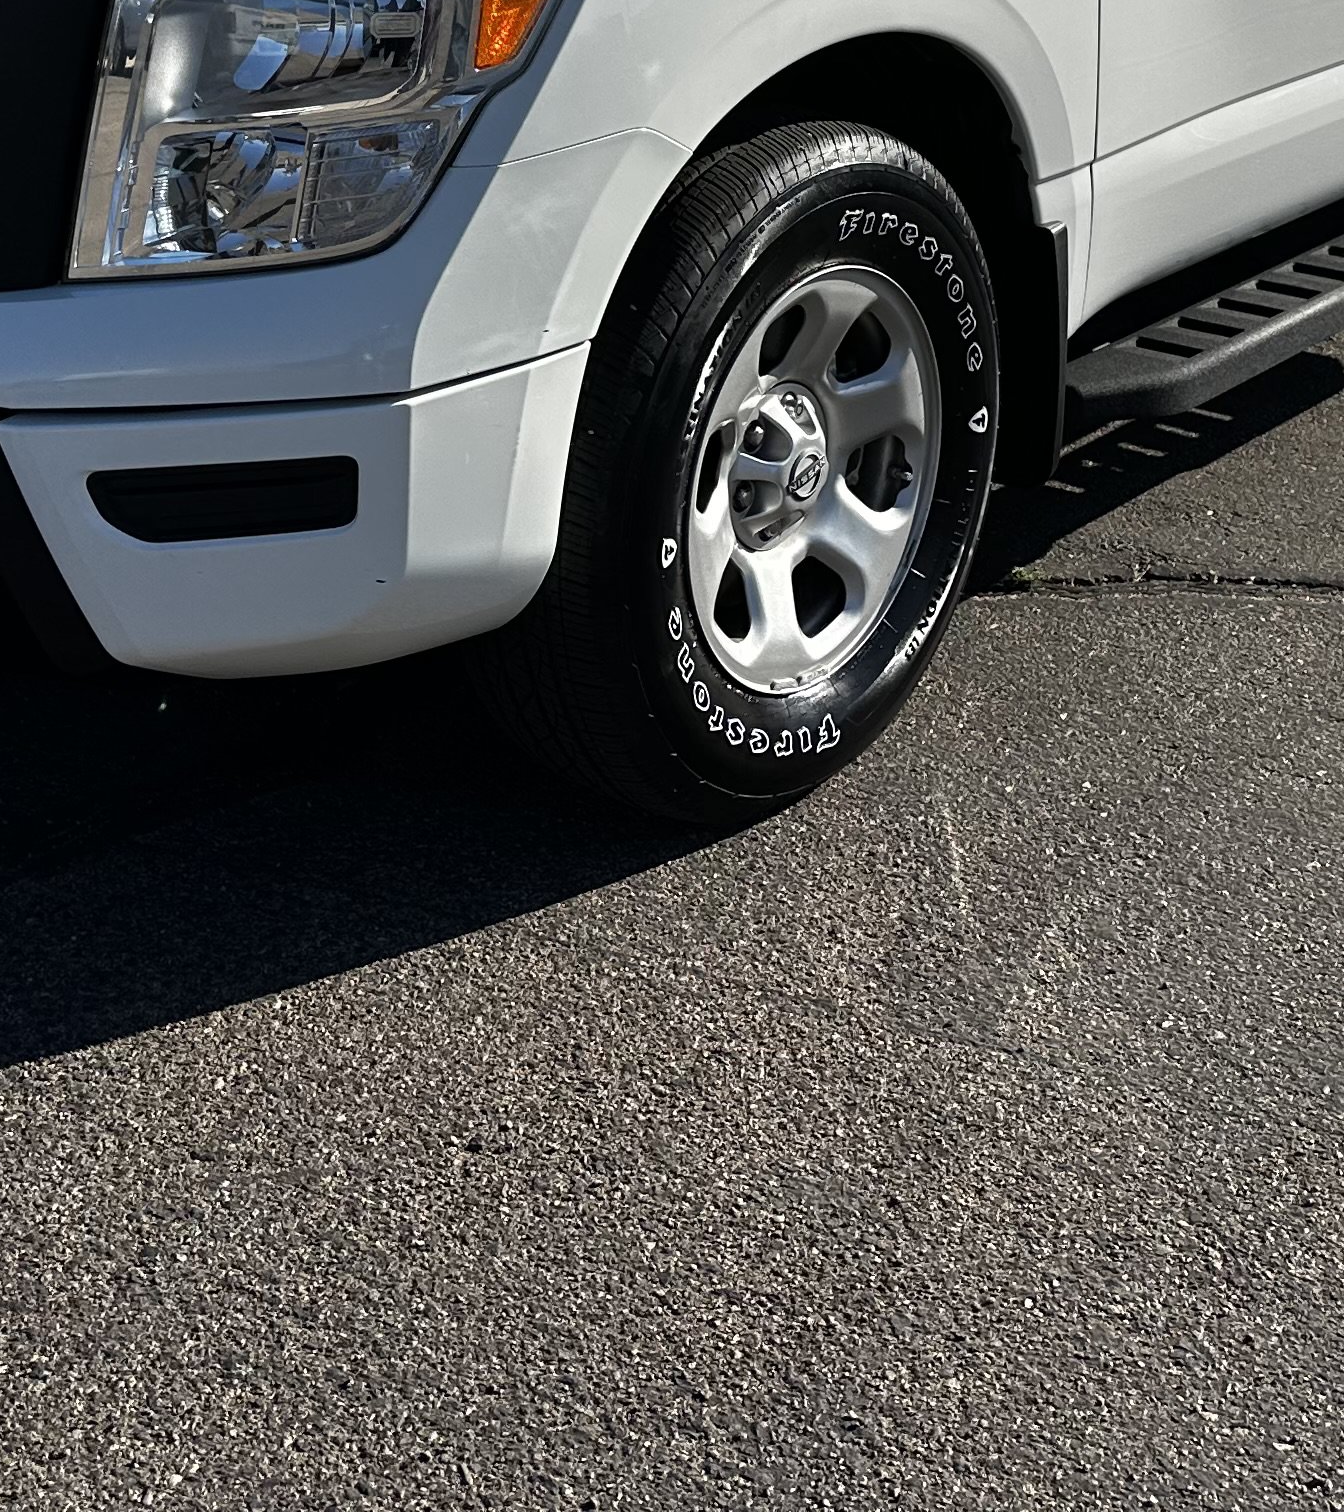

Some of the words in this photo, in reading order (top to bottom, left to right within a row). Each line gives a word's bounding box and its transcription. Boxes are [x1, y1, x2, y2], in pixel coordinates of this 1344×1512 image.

[837, 209, 984, 374] Firestone
[788, 454, 826, 494] NISSAN
[667, 606, 841, 758] Firestone
